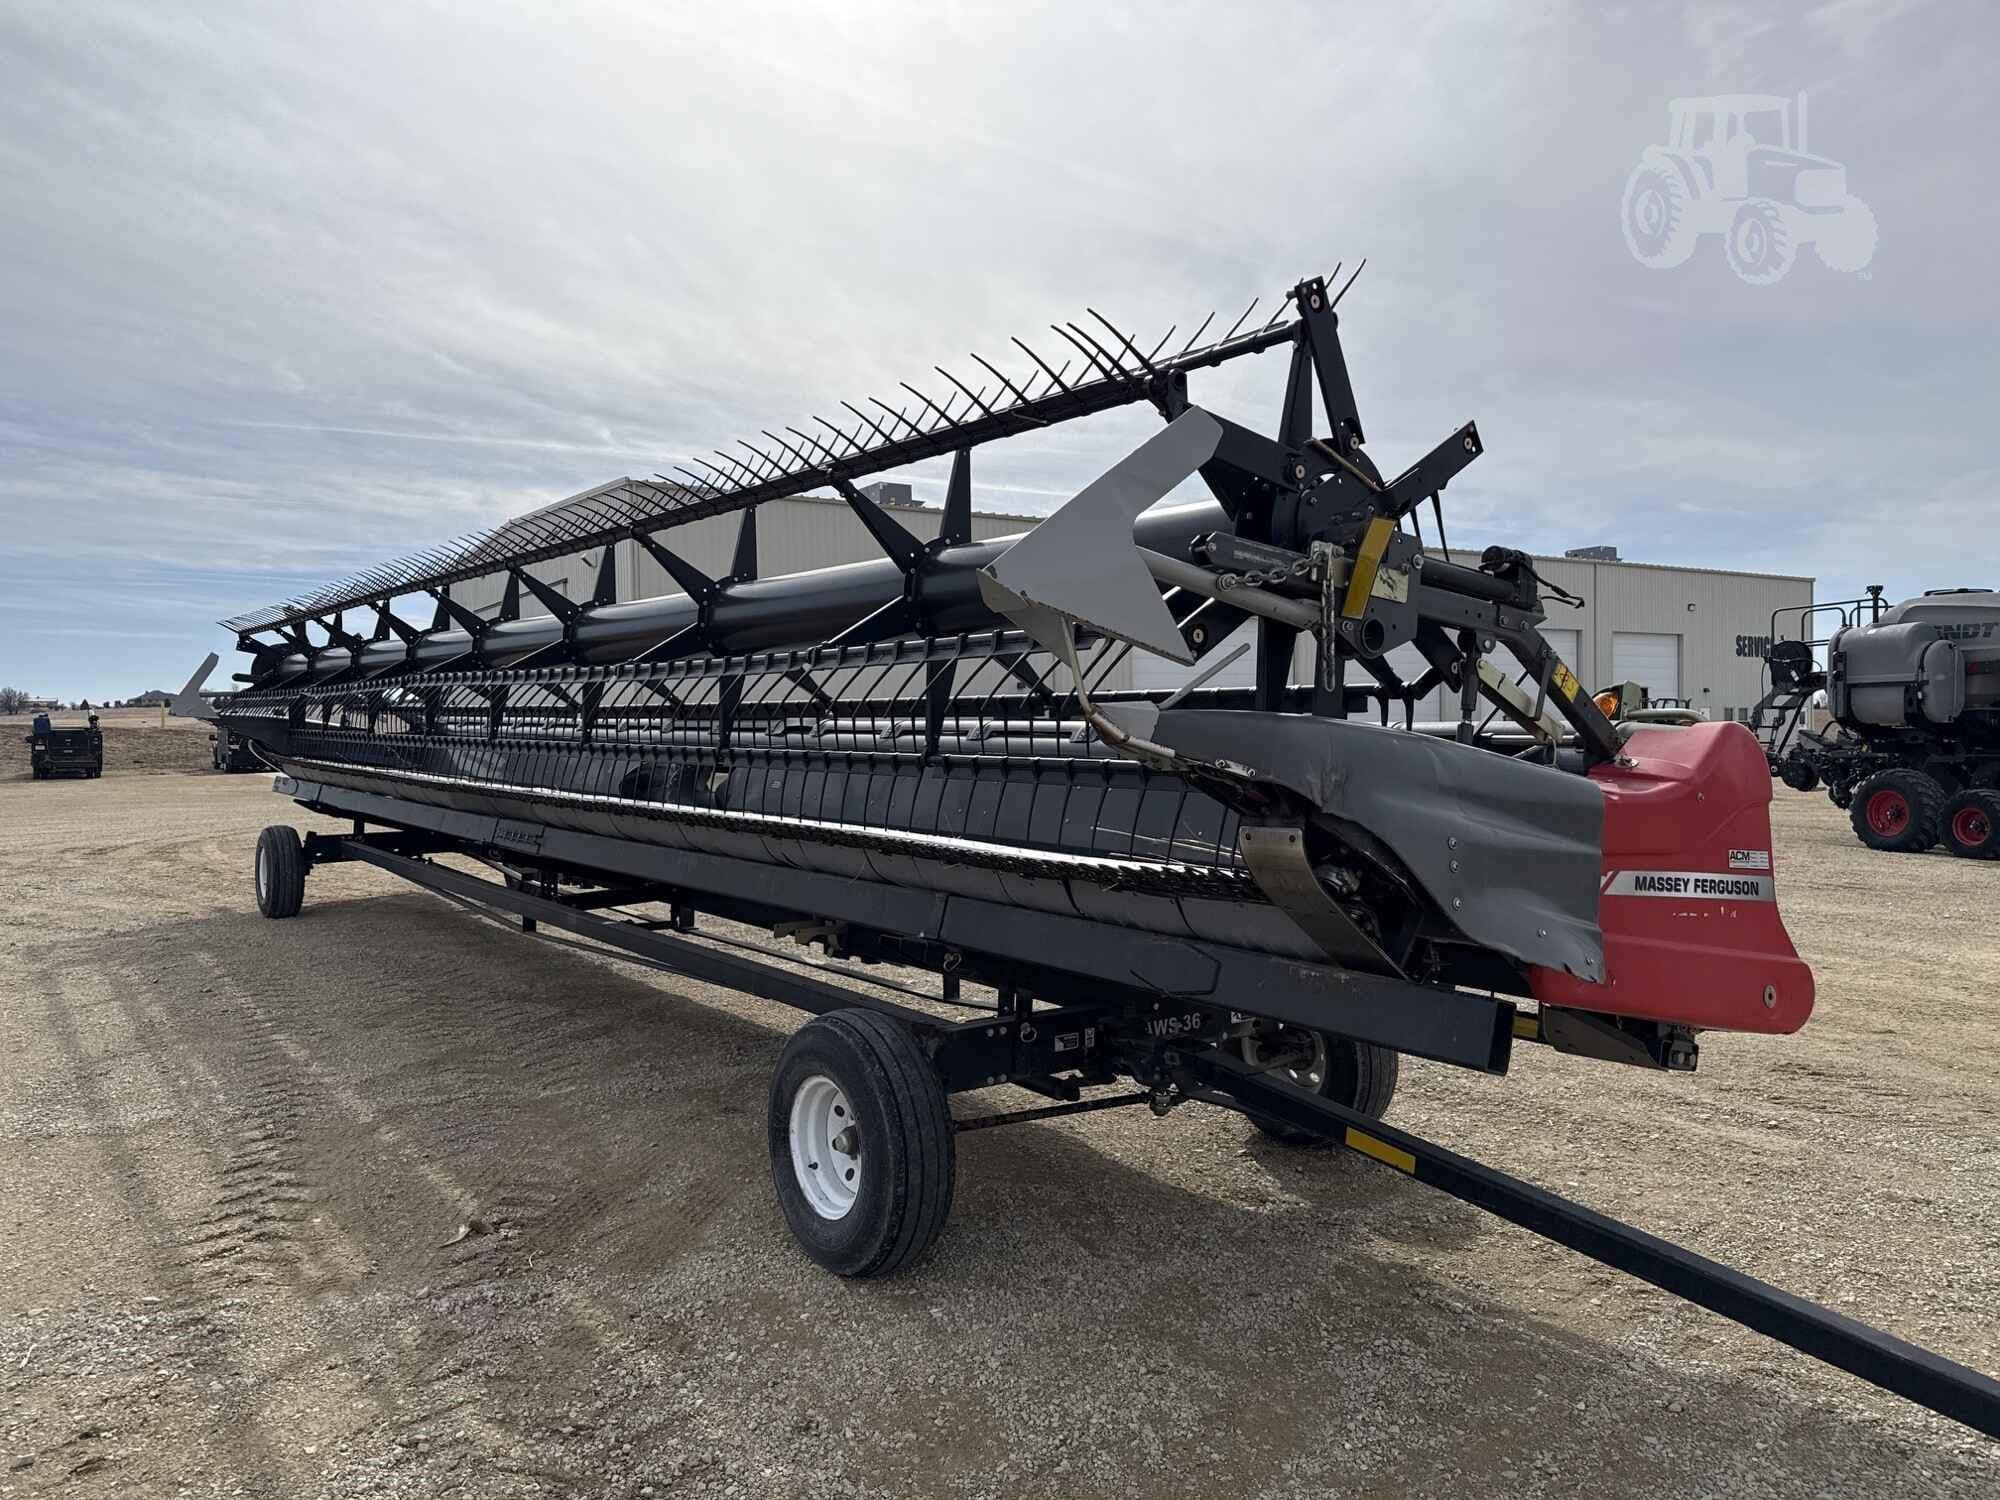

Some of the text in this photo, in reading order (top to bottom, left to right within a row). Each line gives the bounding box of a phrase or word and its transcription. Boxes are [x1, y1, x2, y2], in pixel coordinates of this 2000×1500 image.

[1934, 622, 1999, 640] NDT
[1735, 634, 1771, 658] SERVIC
[1730, 851, 1750, 860] ACM
[1634, 876, 1759, 896] MASSEY FERGUSON
